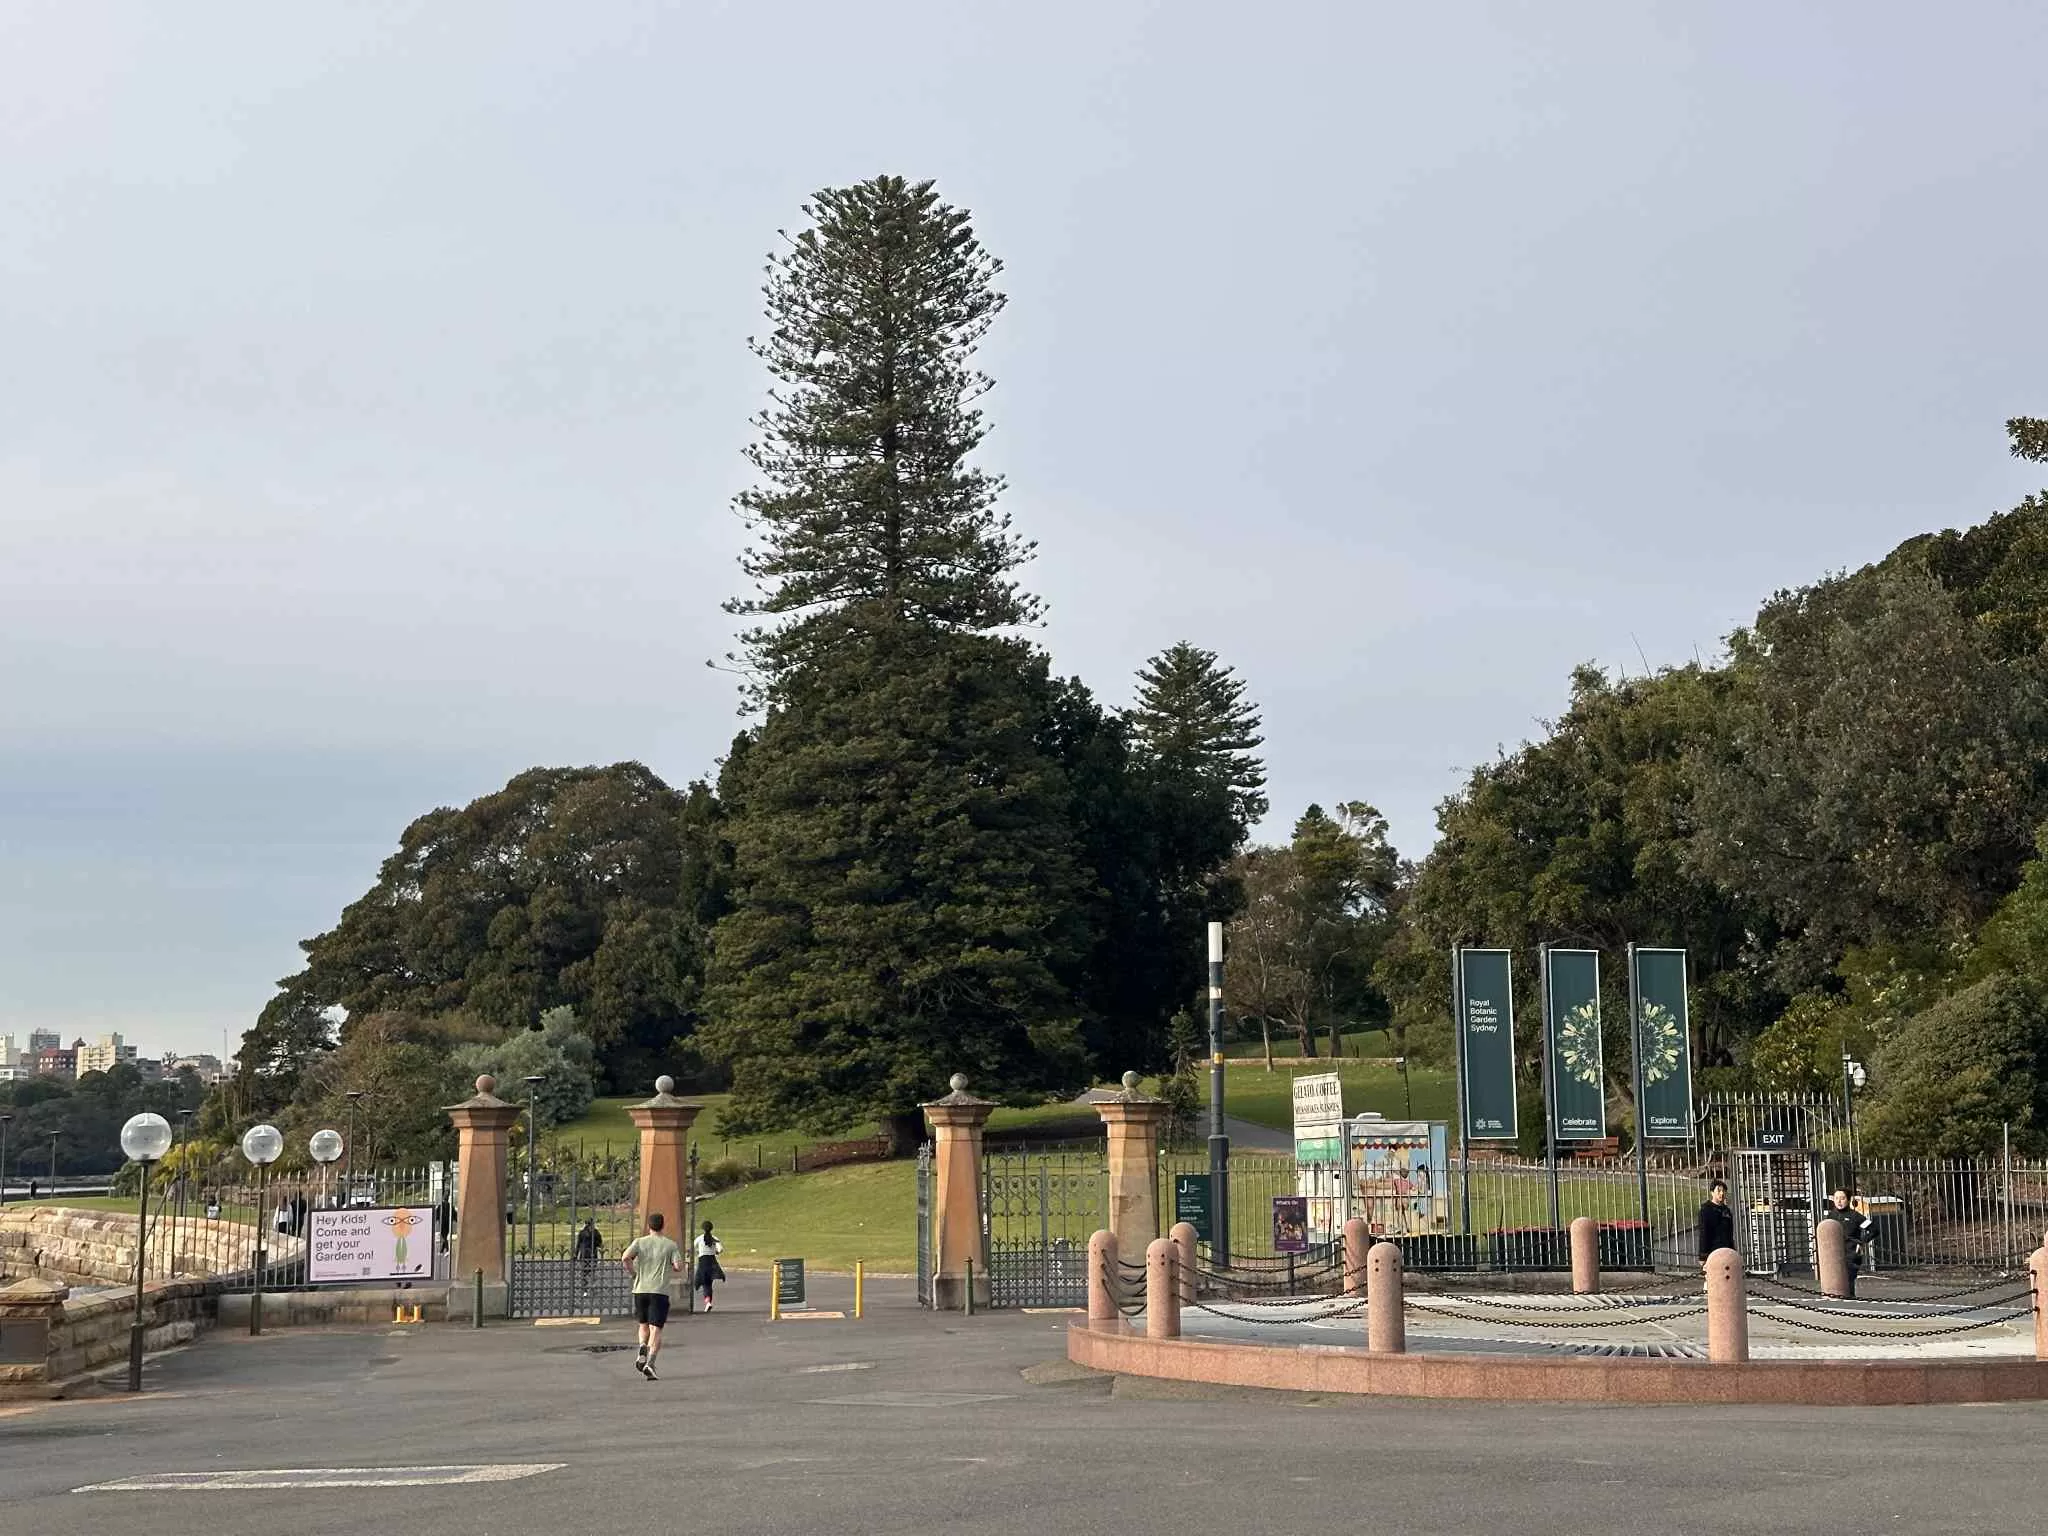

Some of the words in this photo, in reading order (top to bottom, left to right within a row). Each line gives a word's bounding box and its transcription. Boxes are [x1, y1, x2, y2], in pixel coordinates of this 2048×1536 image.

[1469, 999, 1490, 1007] Royal
[1471, 1024, 1498, 1033] Sydney
[1562, 1118, 1597, 1126] Celebrate
[1650, 1116, 1678, 1125] Explore
[1763, 1134, 1785, 1144] EXIT
[1179, 1179, 1188, 1193] J
[316, 1215, 339, 1226] Hey
[341, 1214, 367, 1225] Kids!
[316, 1227, 347, 1238] Come
[350, 1226, 371, 1236] and
[315, 1240, 333, 1252] get
[337, 1239, 360, 1250] your
[315, 1252, 354, 1262] Garden
[357, 1250, 374, 1261] on!
